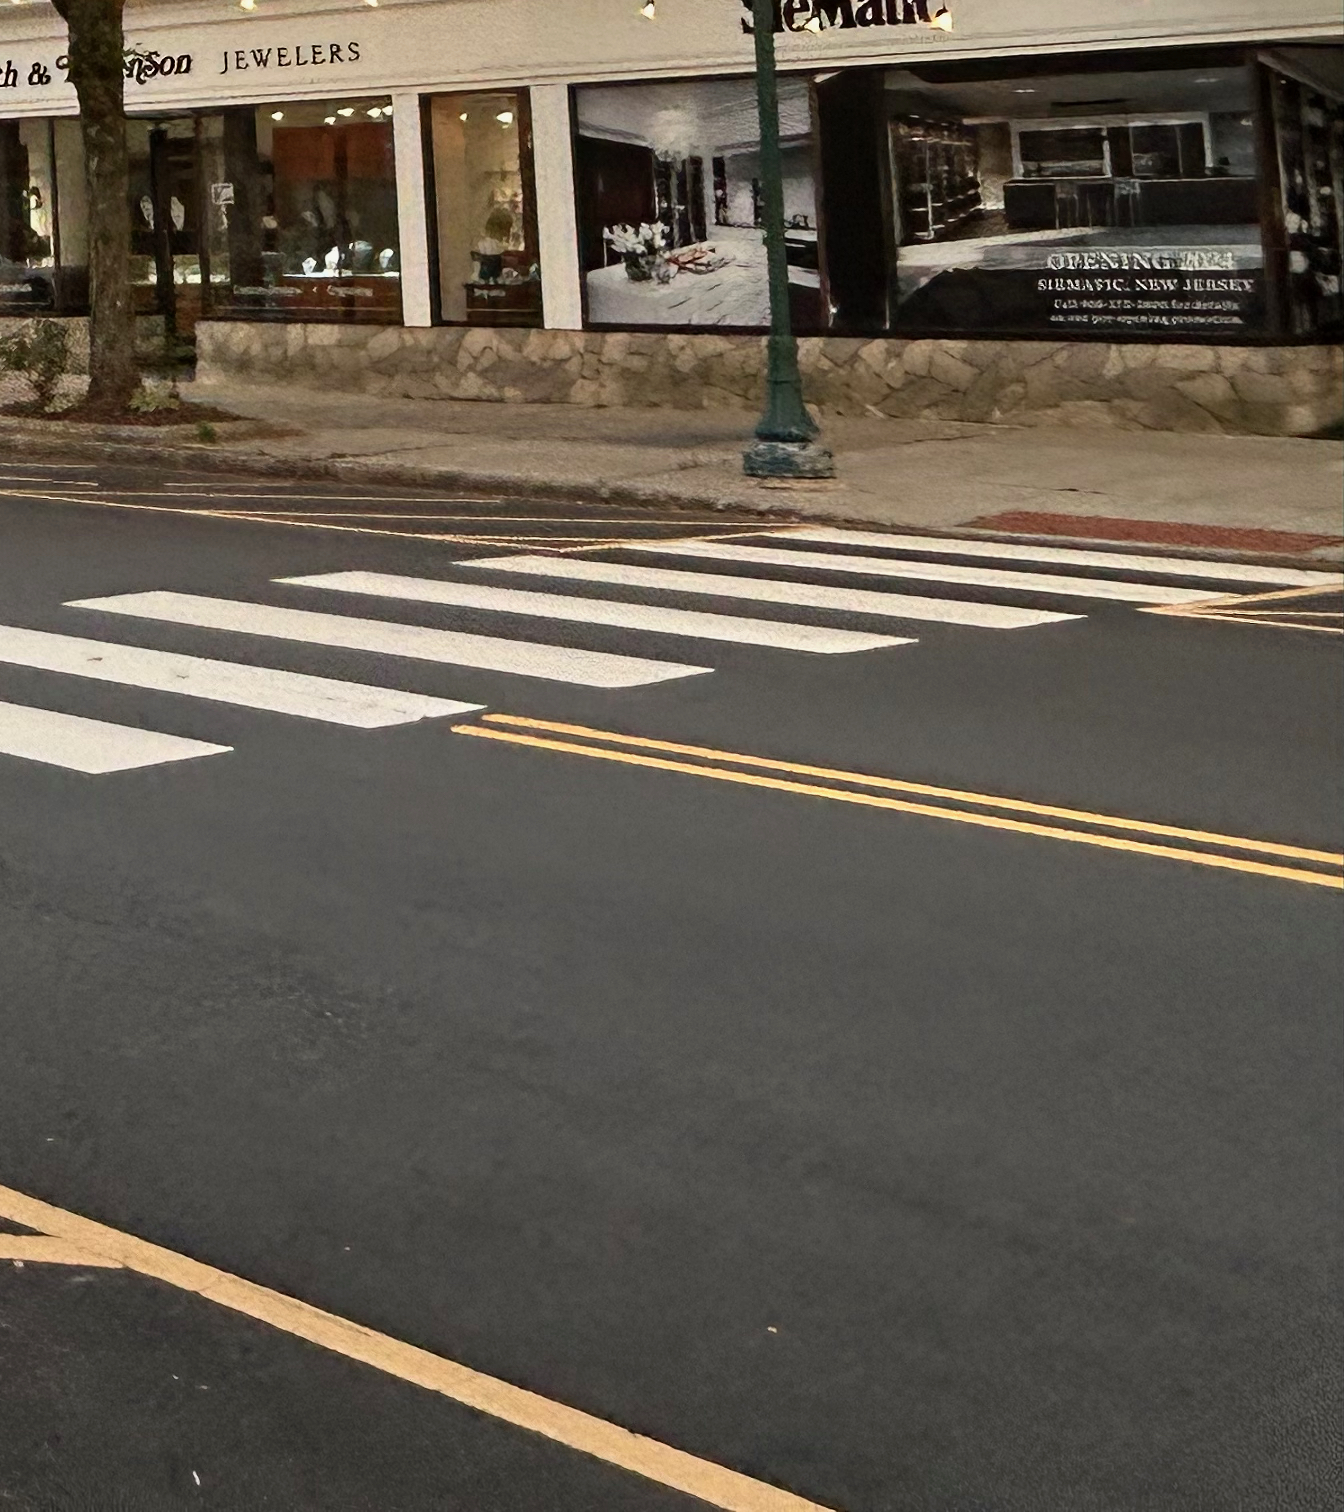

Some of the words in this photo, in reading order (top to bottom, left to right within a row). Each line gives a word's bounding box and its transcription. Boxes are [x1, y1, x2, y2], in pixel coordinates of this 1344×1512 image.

[28, 62, 52, 86] &
[220, 42, 361, 75] JEWELERS
[1047, 252, 1176, 270] OPENING
[1134, 278, 1179, 291] NEW
[1182, 278, 1255, 292] JERSEY
